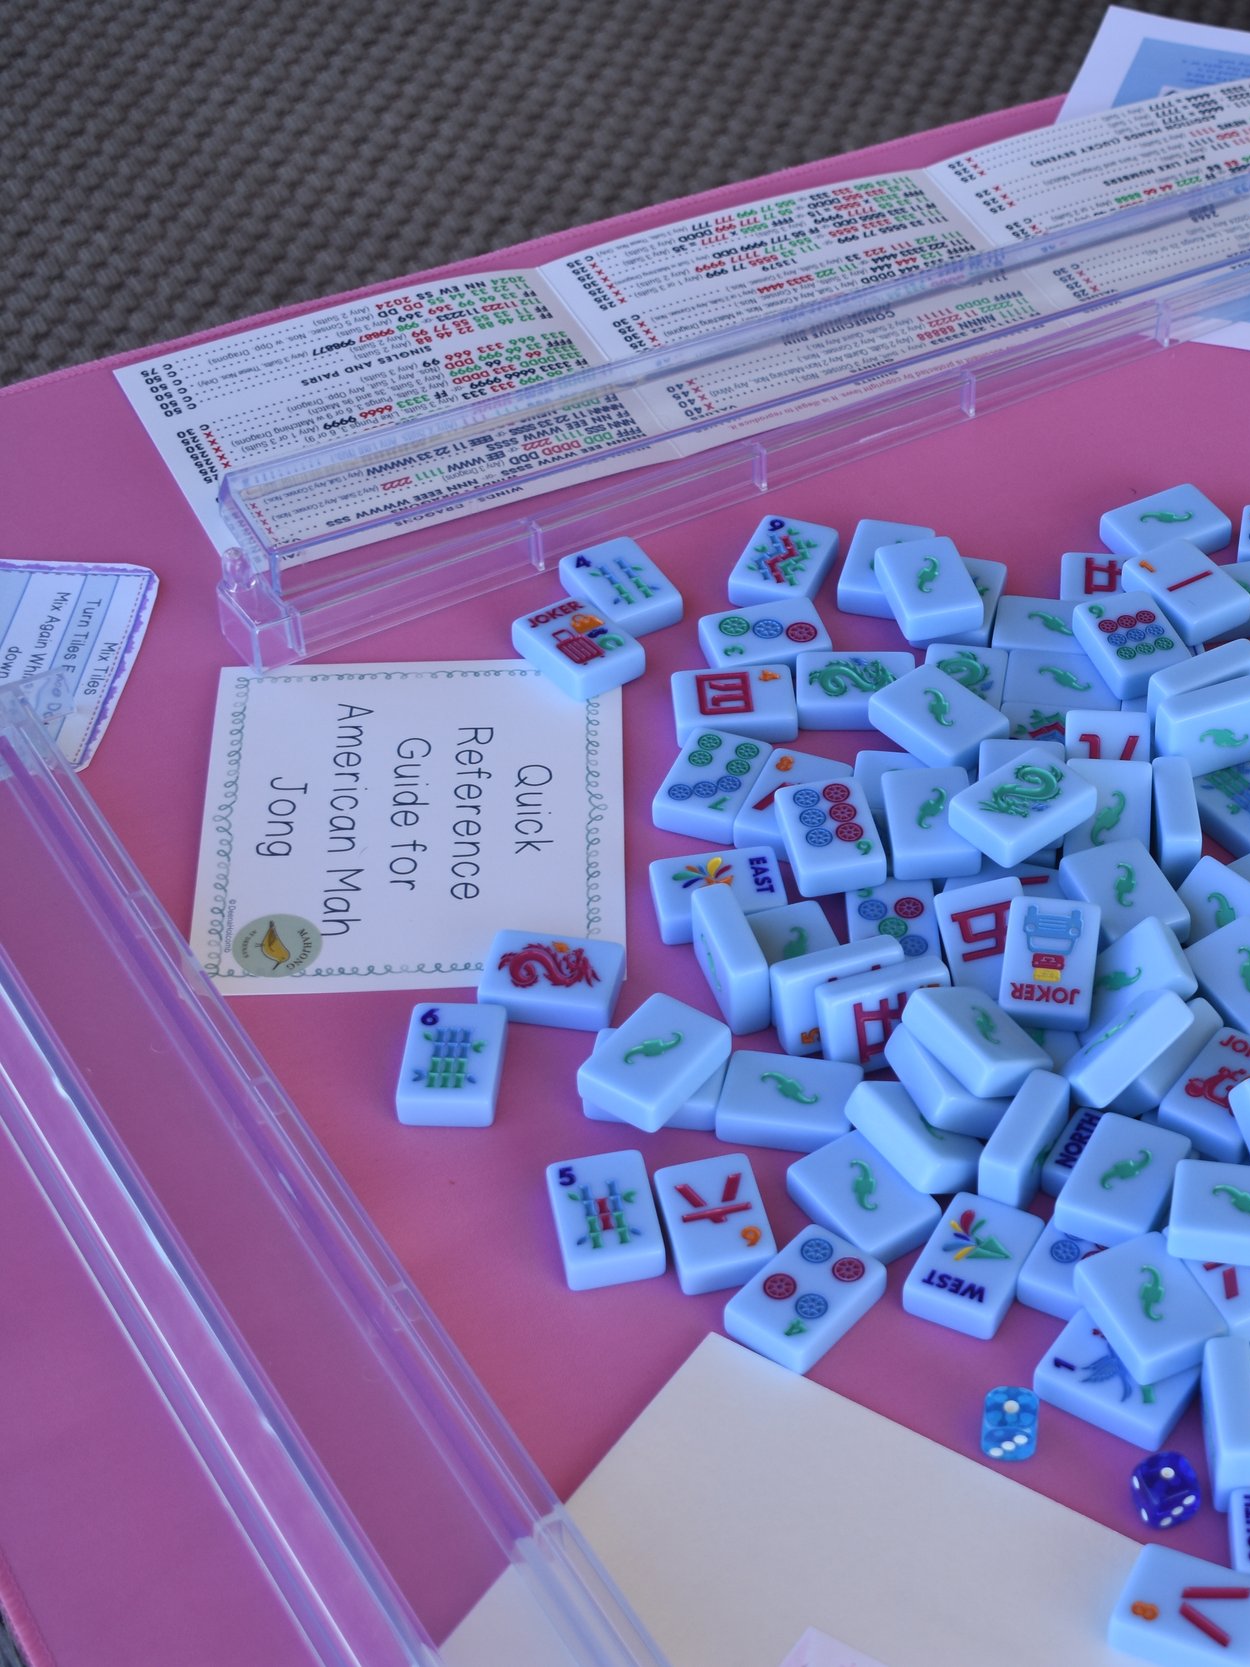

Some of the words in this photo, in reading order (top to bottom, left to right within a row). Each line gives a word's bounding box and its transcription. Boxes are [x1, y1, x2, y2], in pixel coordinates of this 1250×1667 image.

[462, 279, 487, 290] NN
[488, 272, 525, 286] 2024
[414, 290, 434, 300] SS
[436, 284, 461, 296] EW
[373, 295, 413, 310] 2024
[476, 320, 495, 330] 88
[496, 316, 516, 326] 46
[516, 312, 537, 323] 22
[538, 311, 554, 320] FF
[413, 335, 434, 345] 88
[434, 330, 455, 340] 46
[455, 325, 475, 335] 22
[307, 336, 358, 356] 998877
[374, 344, 434, 365] SINGLES
[341, 360, 375, 374] AND
[297, 369, 342, 387] PAIRS
[768, 518, 786, 532] 9
[575, 555, 592, 569] 4
[49, 591, 72, 613] Mix
[79, 598, 103, 628] Turn
[528, 600, 586, 628] JOKER
[34, 615, 56, 650] Again
[64, 631, 90, 660] Tiles
[97, 642, 118, 662] Mix
[83, 664, 109, 696] Tiles
[327, 703, 374, 854] American
[390, 737, 432, 827] Guide
[255, 776, 308, 857] Jong
[450, 726, 494, 901] Reference
[514, 763, 554, 854] Quick
[389, 839, 428, 891] for
[748, 855, 776, 894] EAST
[320, 867, 365, 937] Mah
[285, 928, 312, 970] MAHJONG
[1009, 980, 1081, 1006] JOKER
[420, 1007, 440, 1026] 6
[1054, 1110, 1101, 1170] NORTH
[559, 1166, 577, 1187] 5
[921, 1268, 986, 1304] WEST
